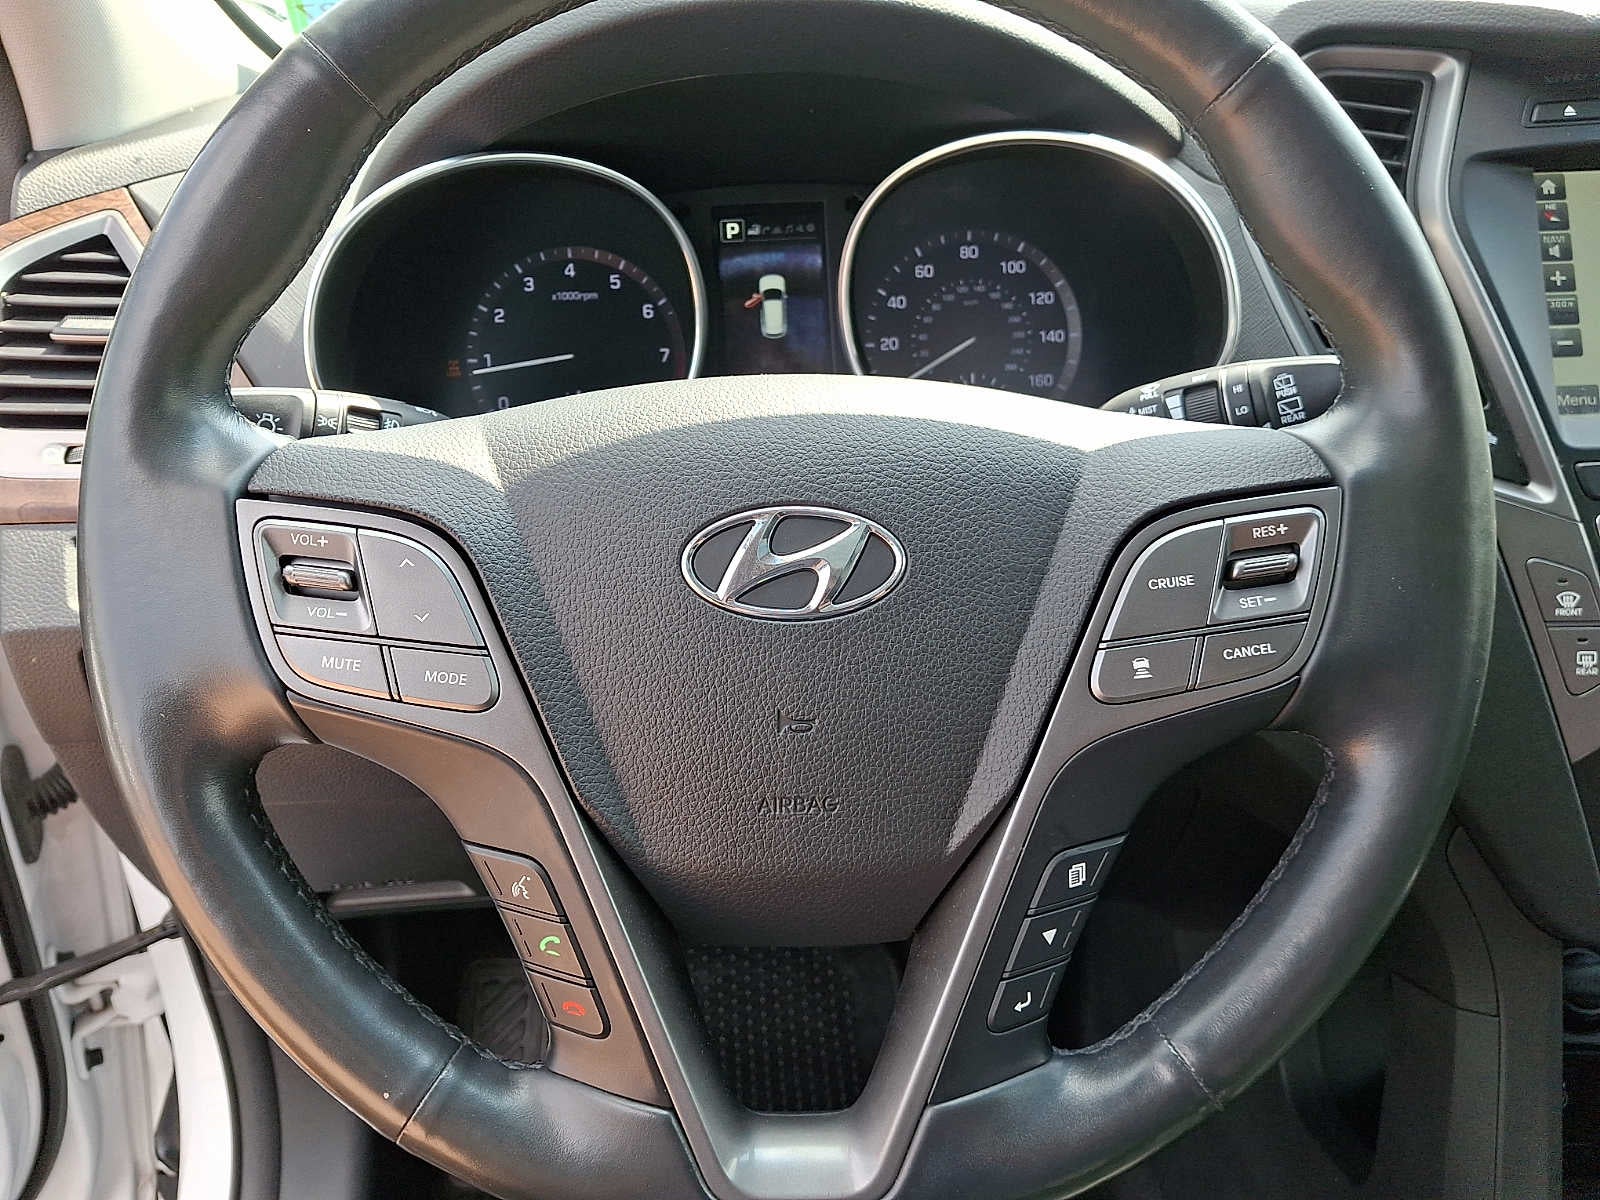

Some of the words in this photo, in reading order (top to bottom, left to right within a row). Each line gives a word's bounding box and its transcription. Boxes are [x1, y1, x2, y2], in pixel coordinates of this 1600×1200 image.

[726, 222, 740, 239] P
[1543, 235, 1565, 243] NAVI
[959, 246, 979, 259] 80
[564, 263, 576, 278] 4
[915, 264, 934, 278] 60
[1000, 260, 1026, 274] 100
[523, 277, 535, 292] 3
[609, 274, 621, 289] 5
[887, 295, 907, 309] 40
[1029, 292, 1055, 305] 120
[493, 308, 505, 323] 2
[642, 304, 654, 319] 6
[1039, 329, 1065, 343] 140
[880, 337, 899, 351] 20
[483, 353, 492, 367] 1
[659, 348, 670, 363] 7
[1029, 374, 1054, 387] 160
[1232, 384, 1243, 394] HI
[1276, 386, 1298, 399] PUSH
[498, 396, 509, 409] 0
[1557, 395, 1597, 406] Menu
[1235, 405, 1248, 416] LO
[1280, 411, 1306, 424] REAR
[1148, 575, 1195, 590] CRUISE
[1554, 607, 1583, 616] FRONT
[1223, 643, 1276, 660] CANCEL
[321, 655, 361, 672] MUTE
[424, 670, 468, 686] MODE
[1575, 667, 1599, 675] REAR
[759, 795, 840, 814] AIRBAG
